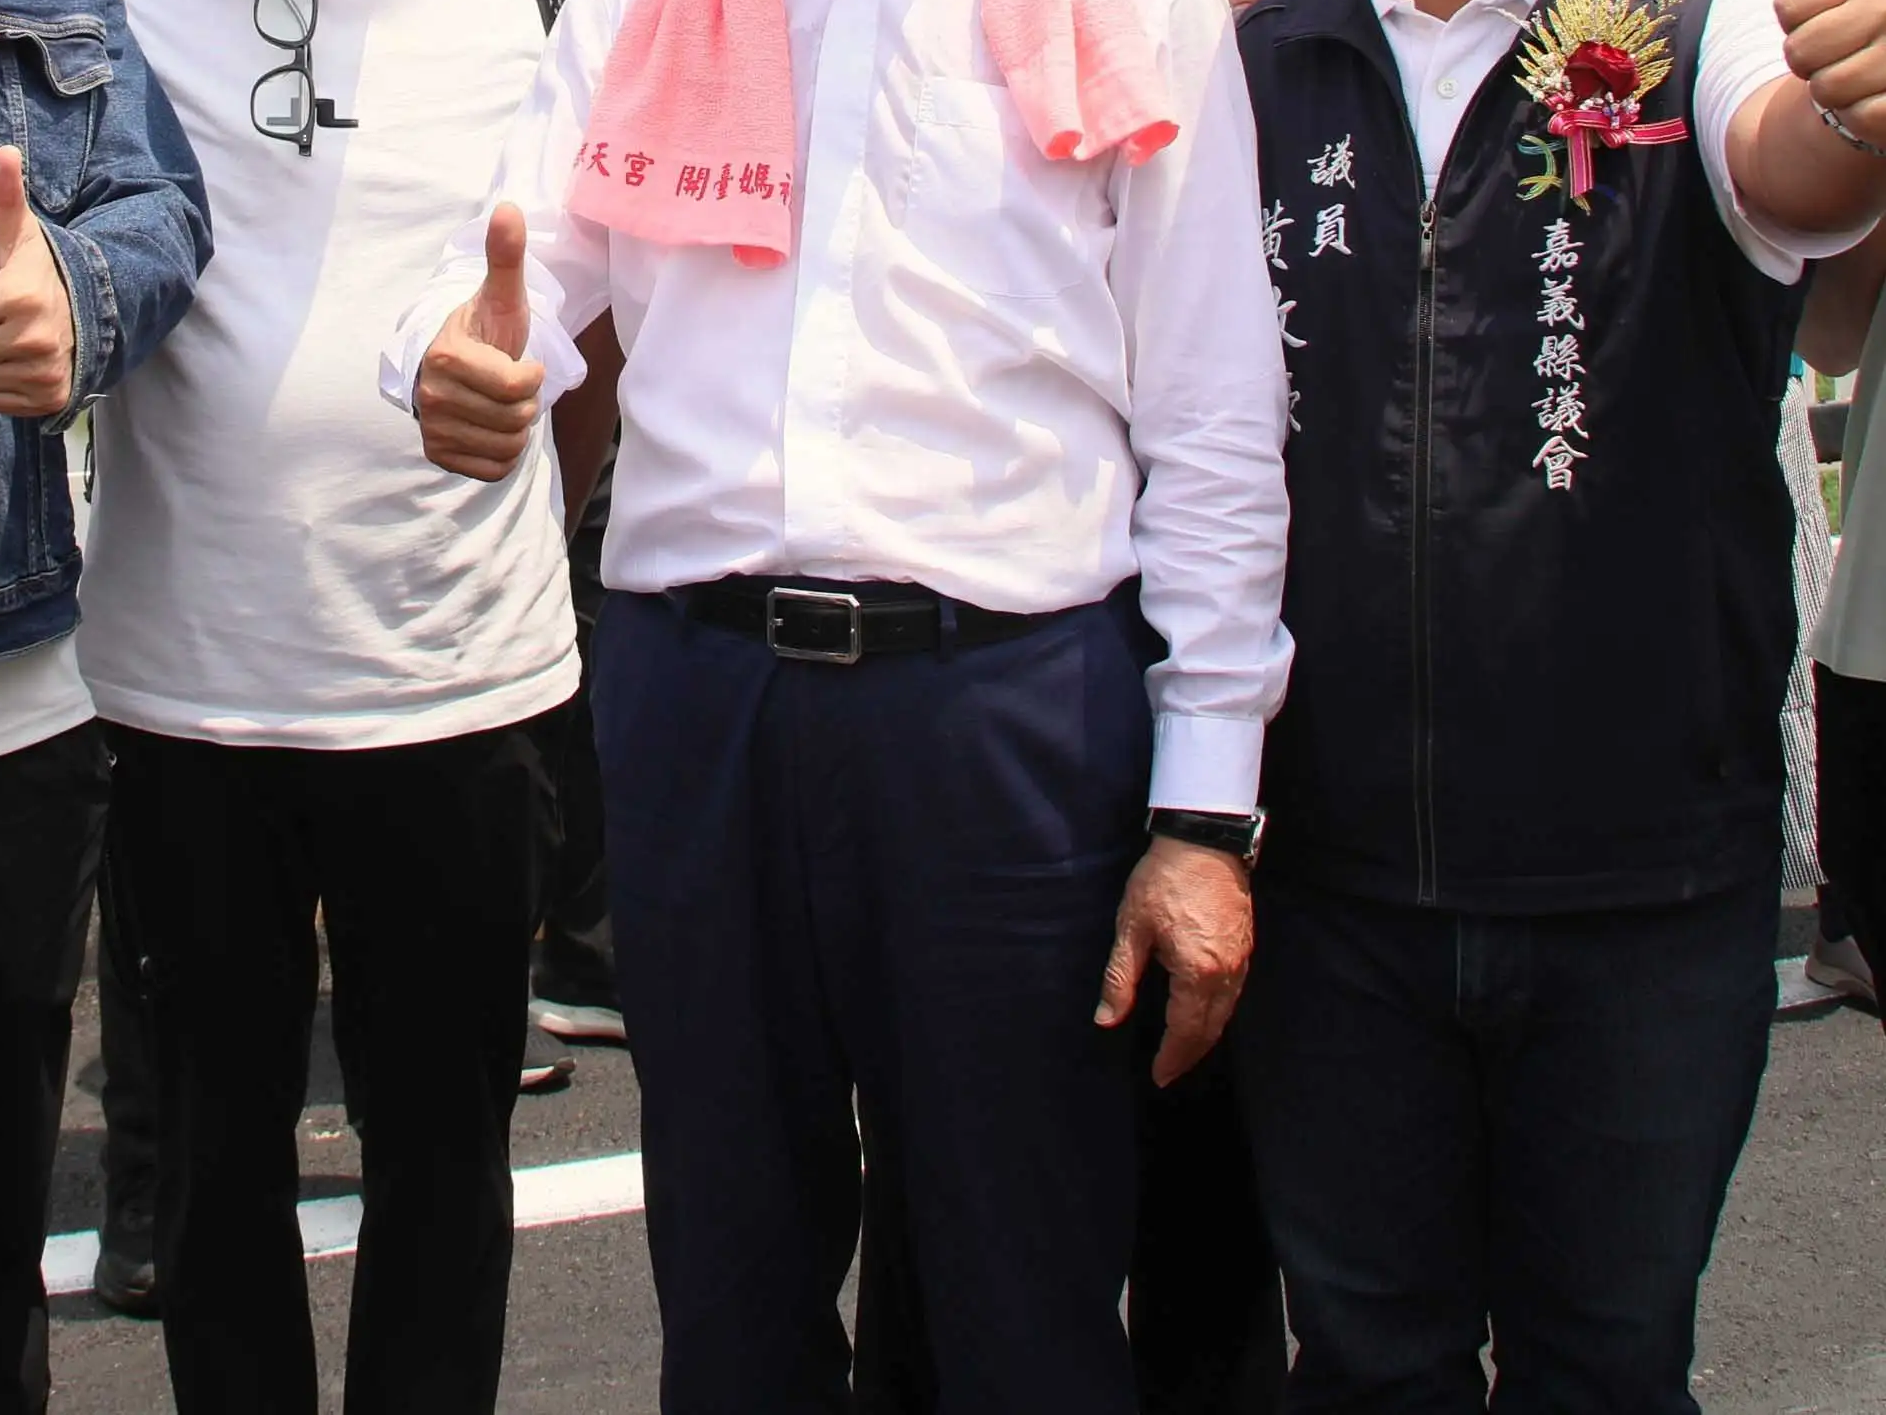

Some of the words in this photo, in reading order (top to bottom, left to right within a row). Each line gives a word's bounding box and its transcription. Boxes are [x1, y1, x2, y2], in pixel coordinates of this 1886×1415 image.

[1307, 133, 1356, 258] 議員
[1531, 217, 1589, 492] 嘉義縣議會
